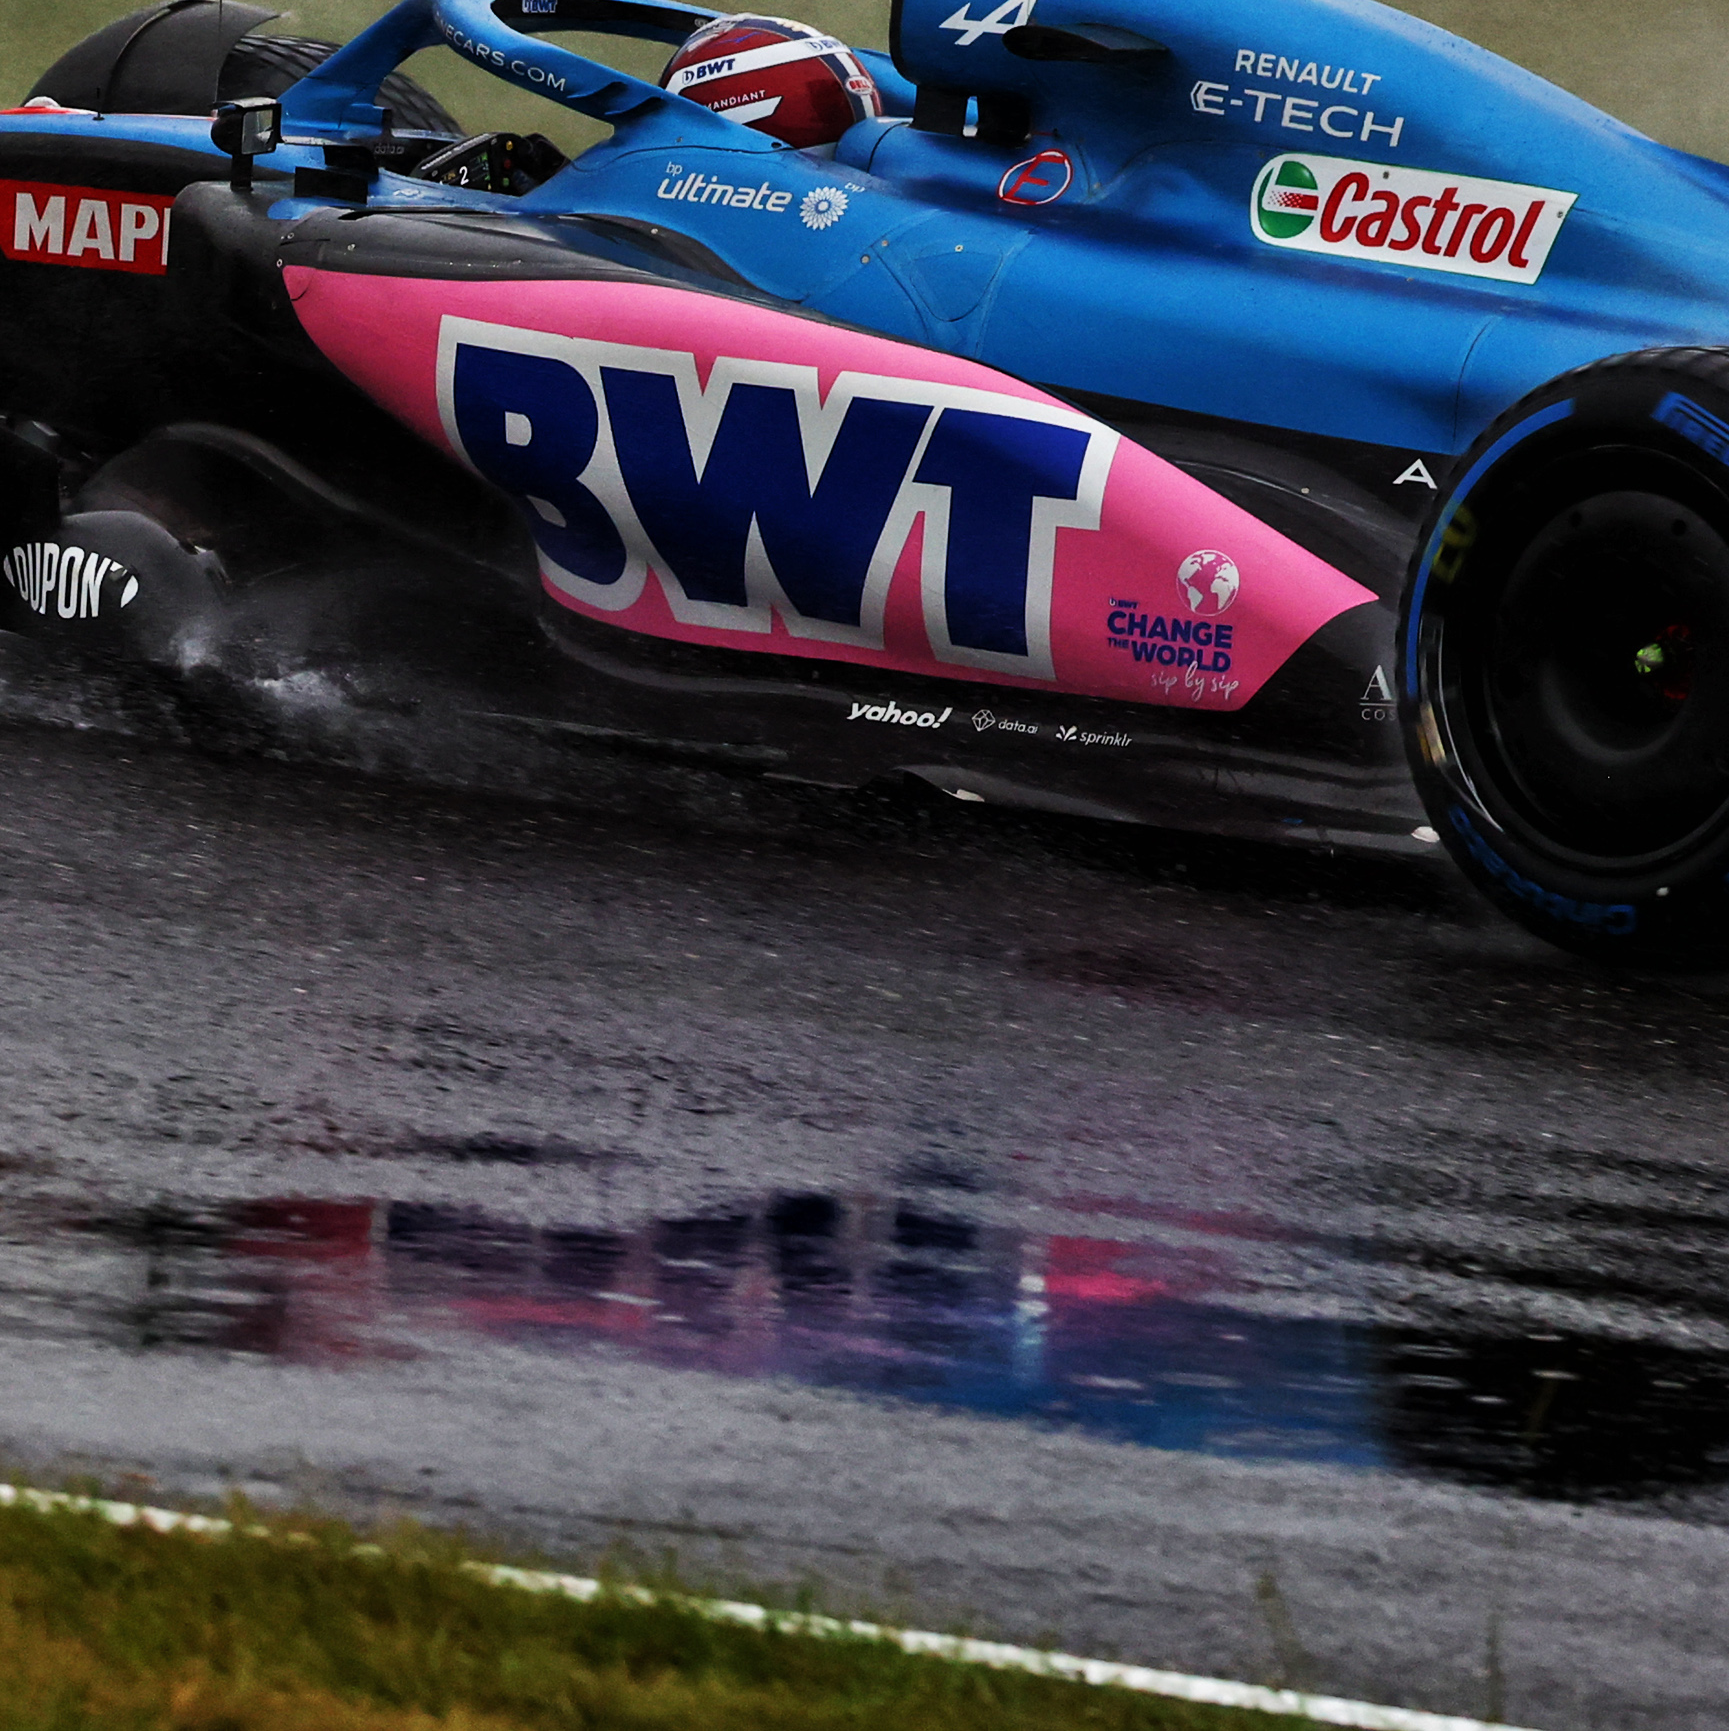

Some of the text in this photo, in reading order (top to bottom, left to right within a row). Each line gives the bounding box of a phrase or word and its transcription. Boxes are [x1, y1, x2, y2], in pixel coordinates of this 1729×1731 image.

[696, 57, 737, 81] BWT
[1235, 48, 1381, 96] RENAULT
[1190, 80, 1404, 148] E-TECH
[459, 165, 469, 186] 2
[665, 161, 684, 176] bp
[656, 175, 793, 213] ultimate
[1319, 171, 1546, 269] Castrol
[453, 341, 1093, 657] BWT
[1107, 610, 1234, 650] CHANGE
[1107, 637, 1231, 673] THE WORLD
[1211, 675, 1240, 700] sip
[846, 700, 1133, 748] yahoo! data.ai sprinklr
